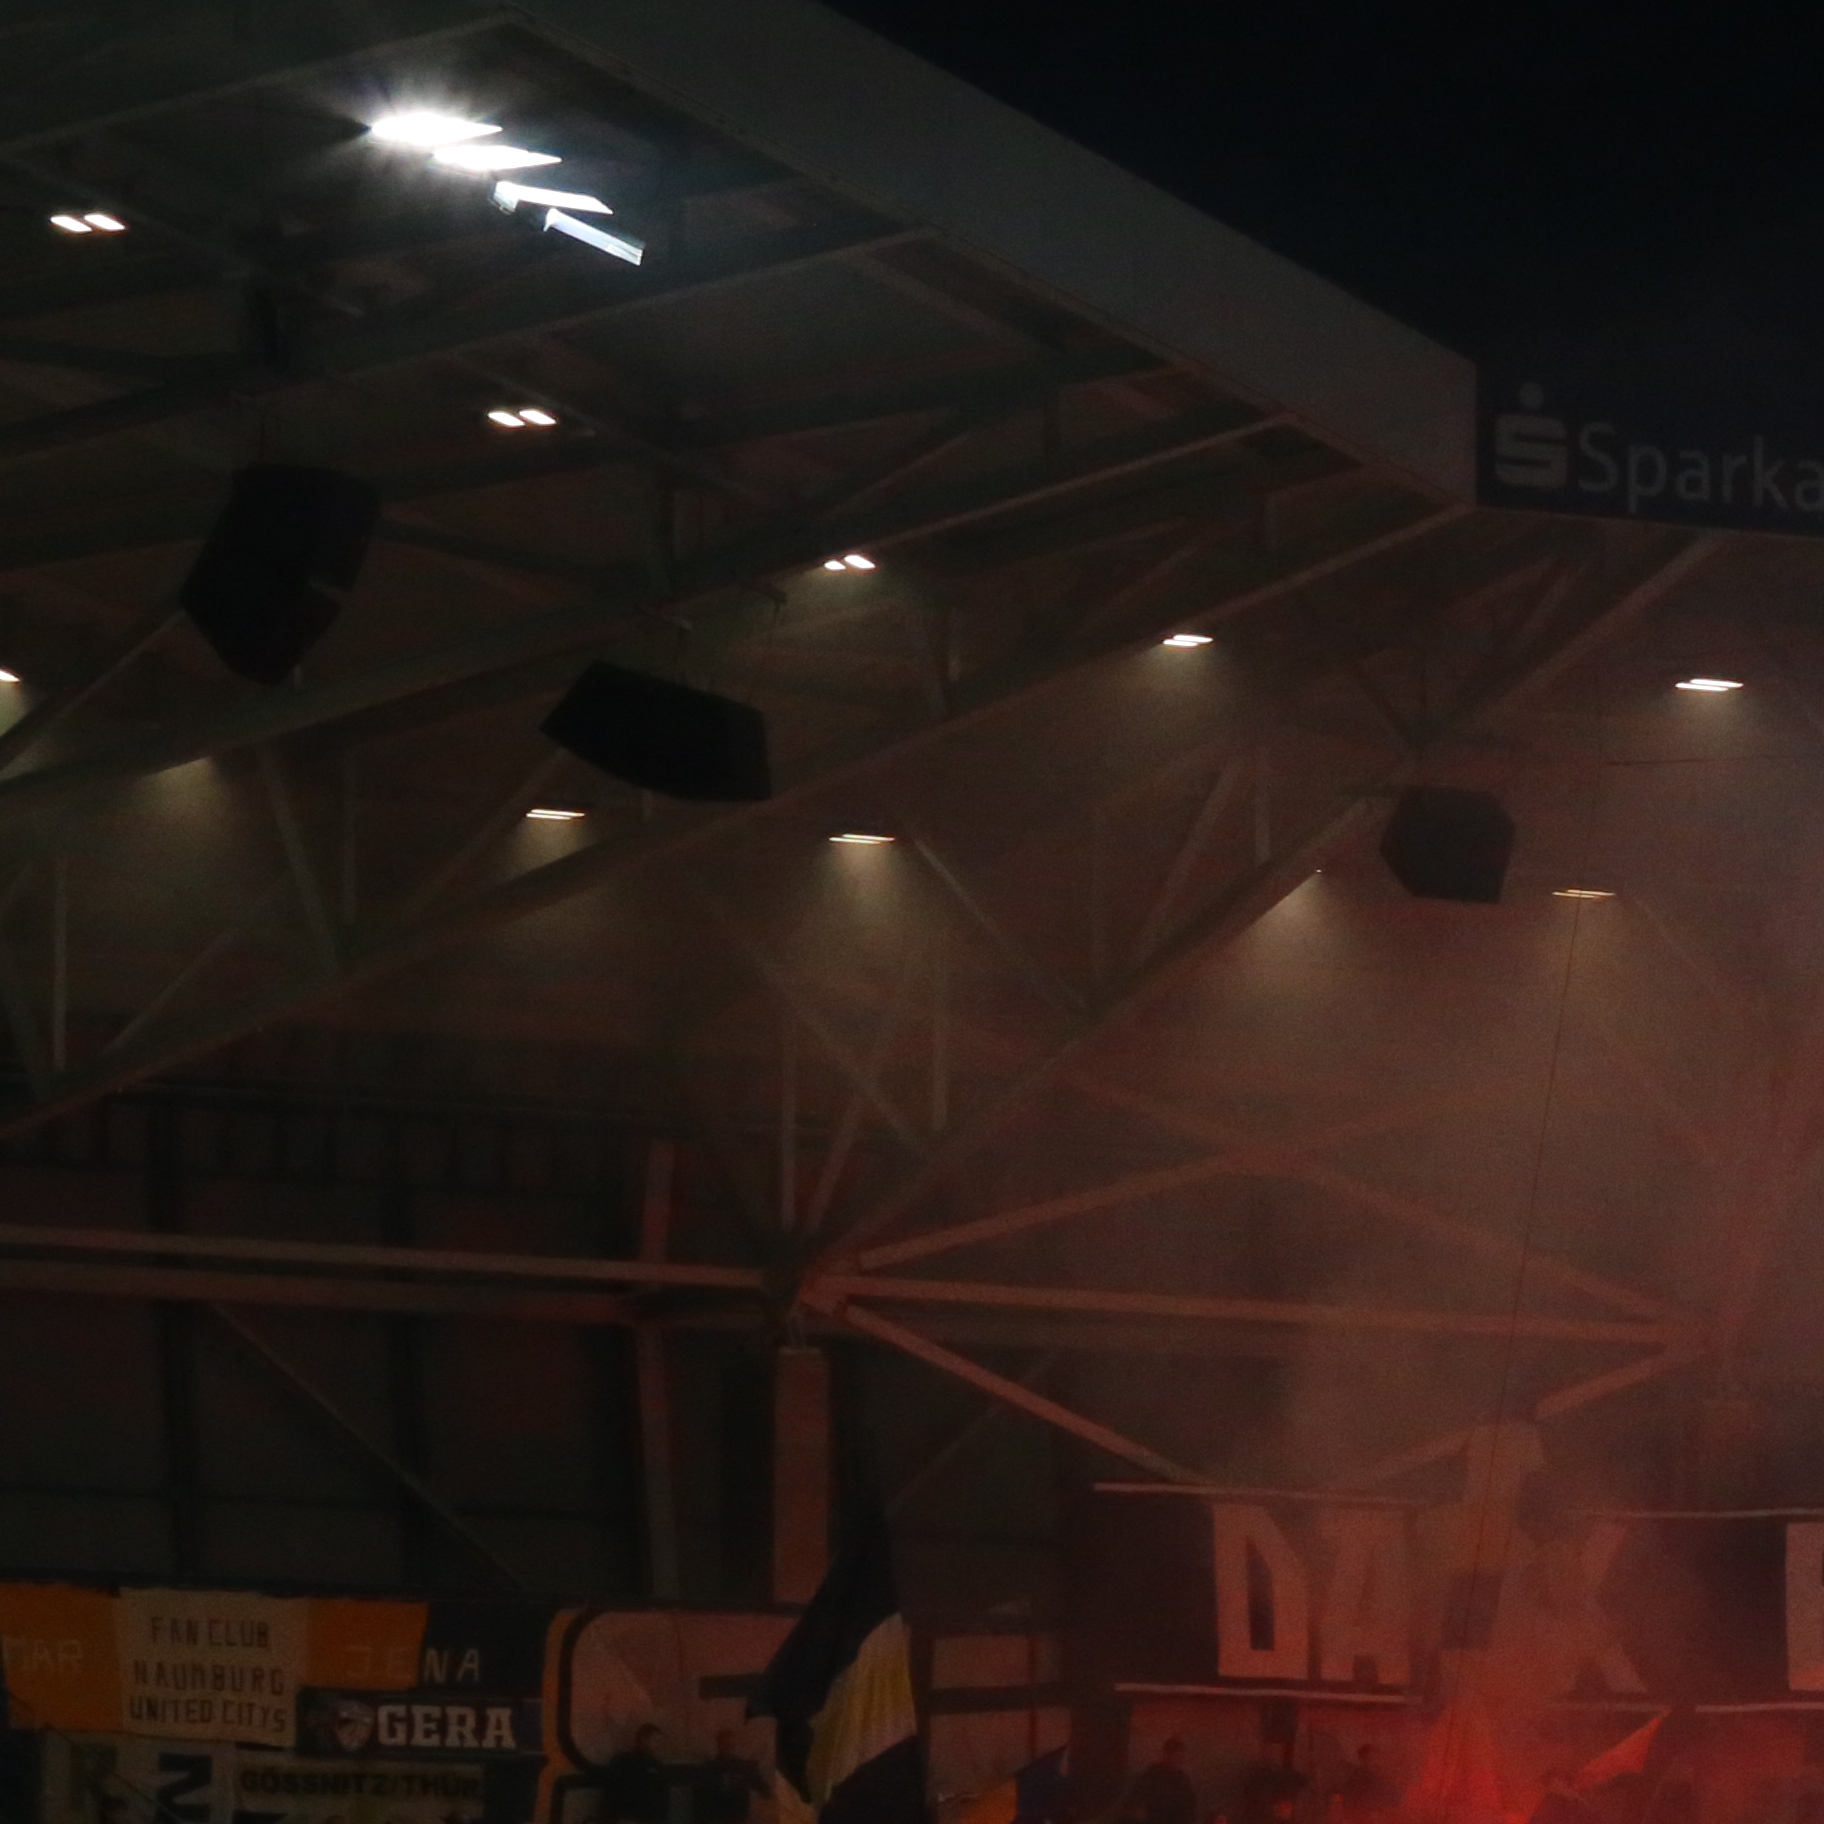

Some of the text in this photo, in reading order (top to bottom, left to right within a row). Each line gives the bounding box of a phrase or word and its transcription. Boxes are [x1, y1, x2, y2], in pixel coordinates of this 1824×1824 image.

[149, 1614, 270, 1650] FAN CLUB
[133, 1660, 285, 1698] NAUMBURG
[346, 1643, 483, 1685] JENA
[377, 1703, 517, 1750] GERA
